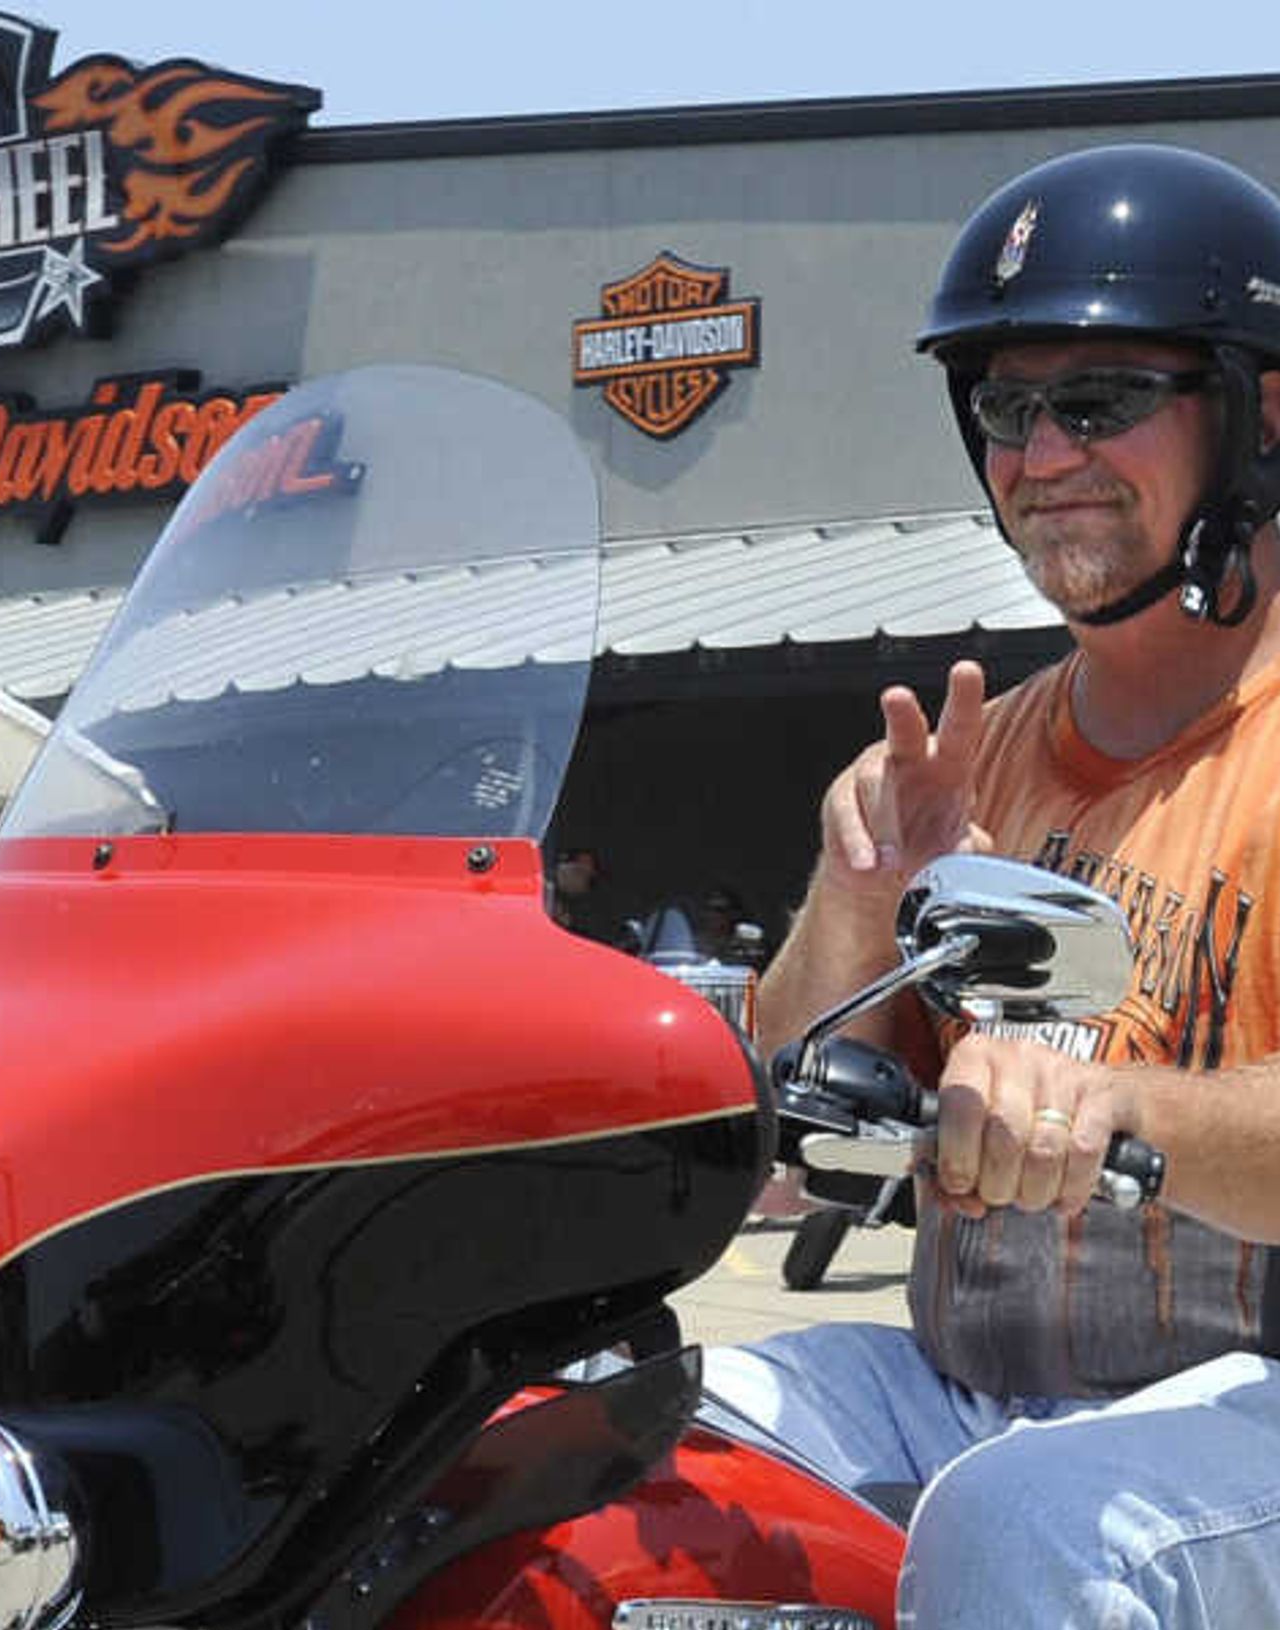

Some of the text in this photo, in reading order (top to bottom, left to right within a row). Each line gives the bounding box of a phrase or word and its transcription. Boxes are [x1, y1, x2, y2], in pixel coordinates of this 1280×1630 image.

[617, 273, 703, 314] MOTOR
[581, 315, 744, 369] HARLEY-DAVIDSON
[618, 372, 703, 422] CYCLES
